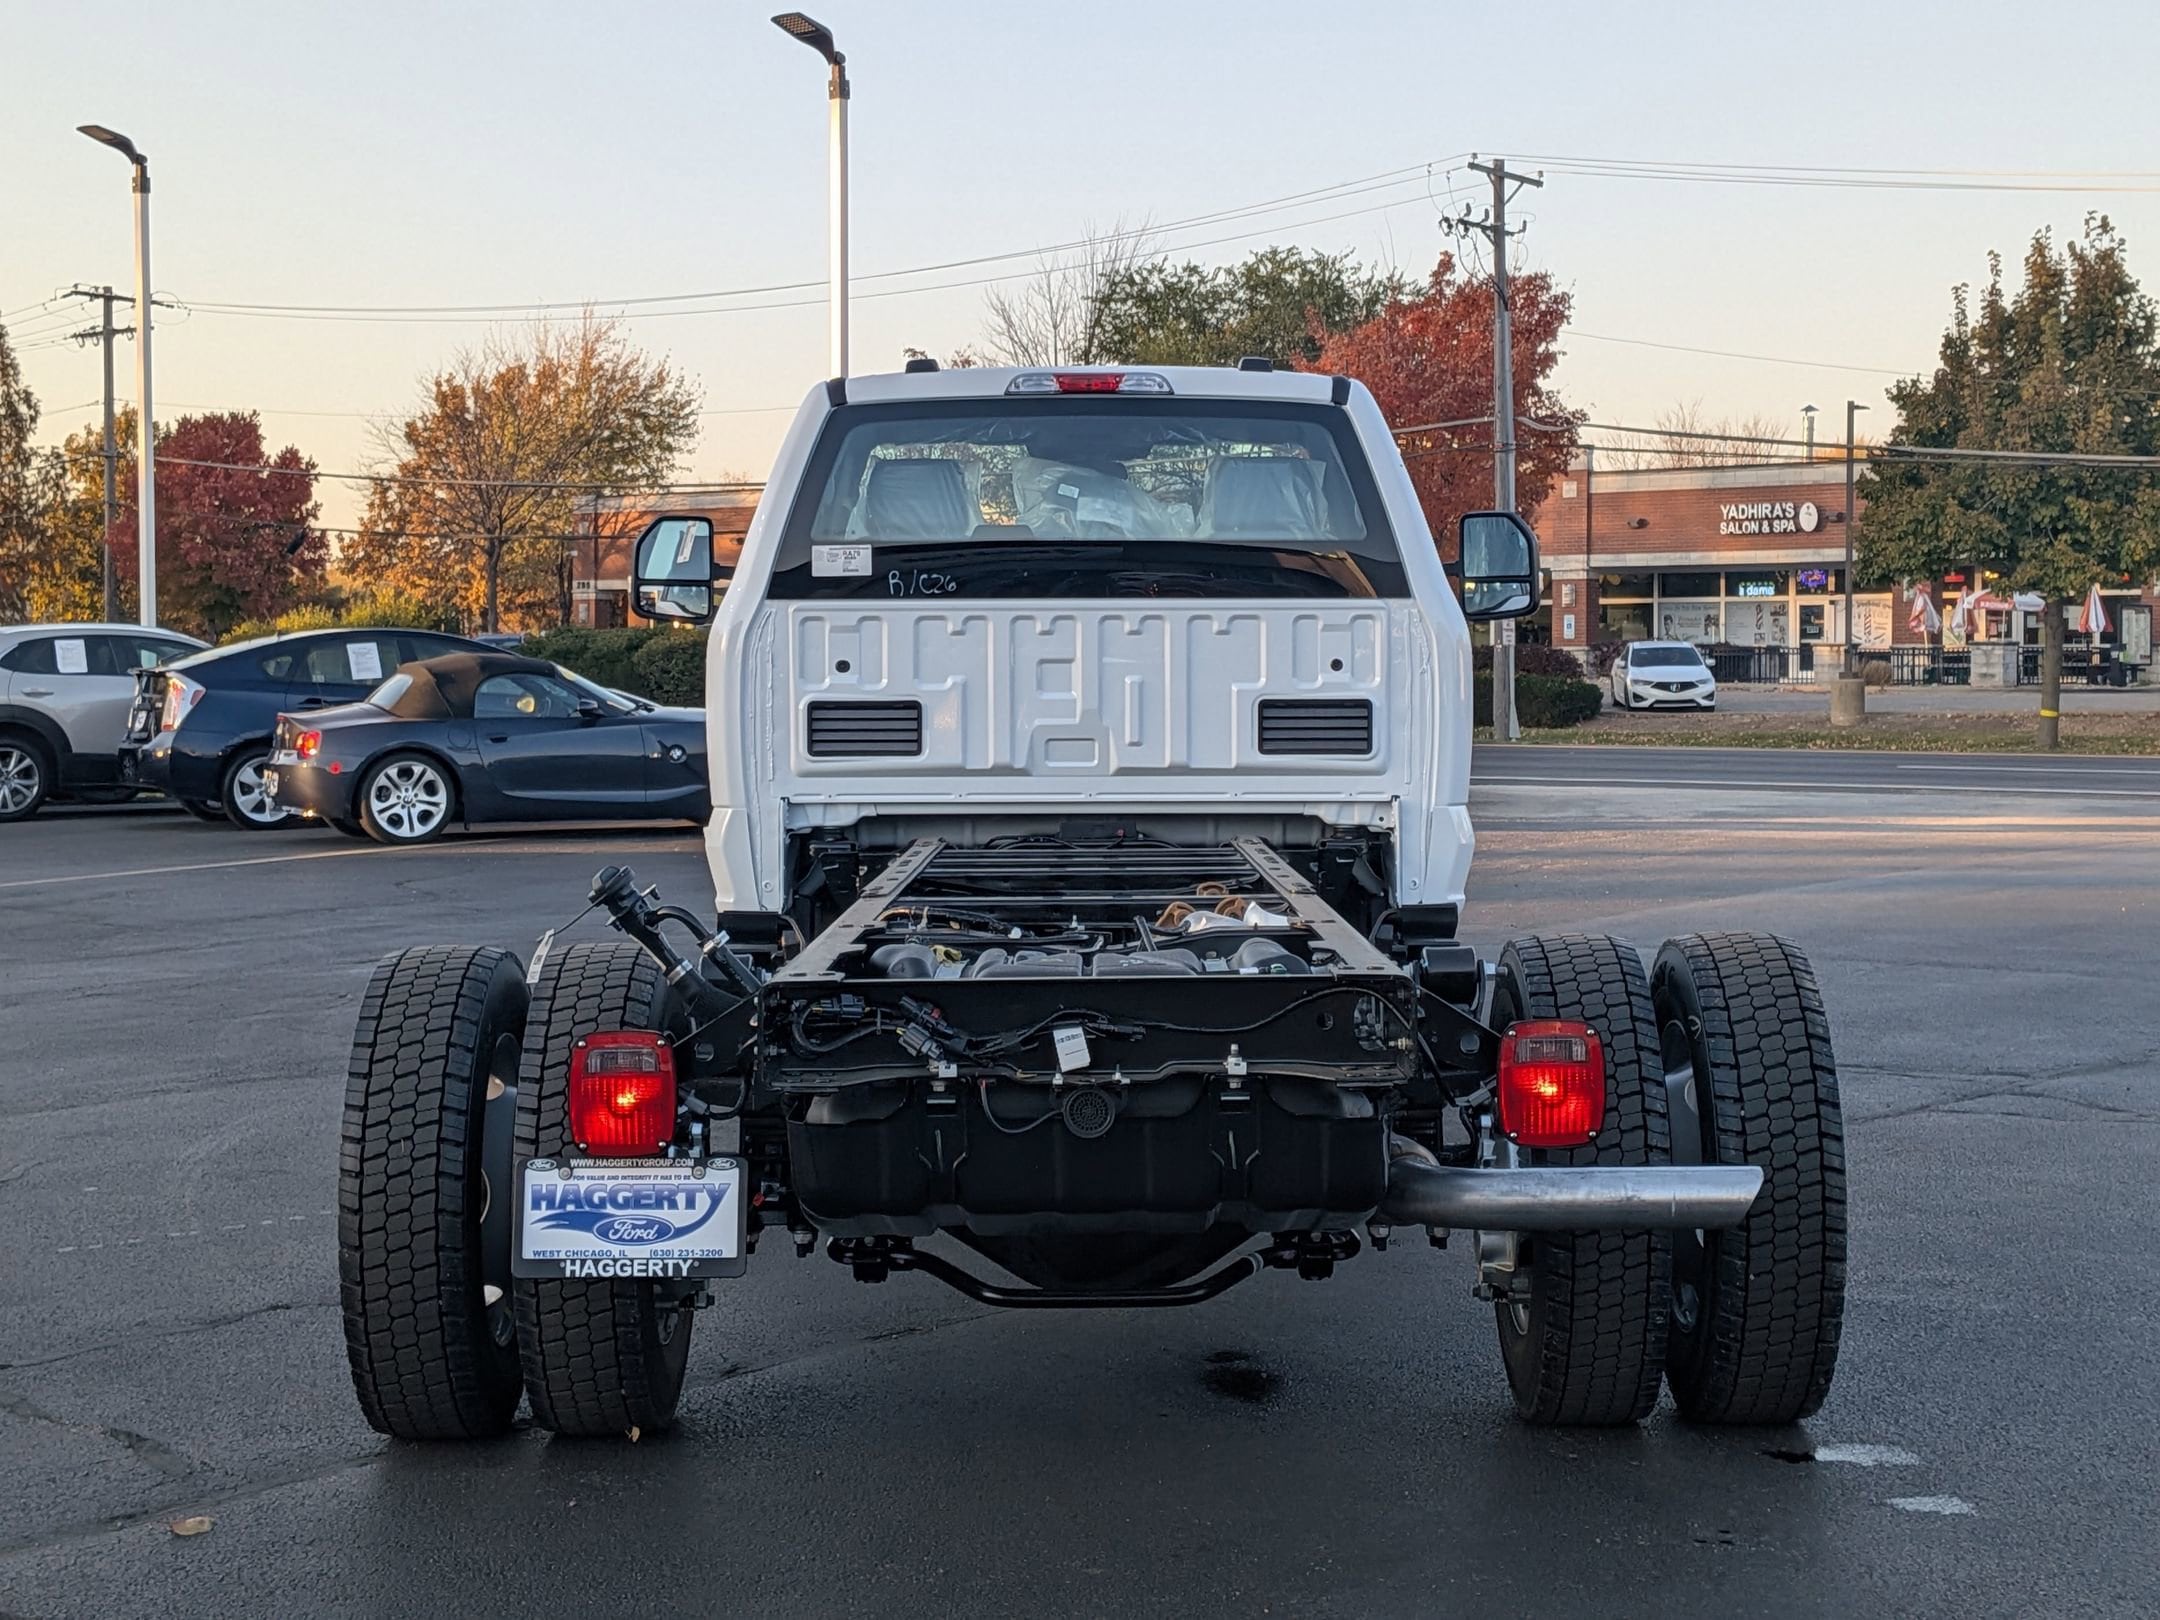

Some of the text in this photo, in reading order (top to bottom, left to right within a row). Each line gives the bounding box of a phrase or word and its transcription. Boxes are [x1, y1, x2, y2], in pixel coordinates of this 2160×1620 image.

[1720, 502, 1795, 520] YADHIRA'S
[1720, 520, 1796, 535] SALON & SPA
[570, 1158, 695, 1168] WWW.HAGGERTYGROUP.COM
[531, 1183, 731, 1212] HAGGERTY
[609, 1218, 658, 1240] Ford
[564, 1250, 616, 1258] CHICAGO,
[650, 1249, 674, 1258] (630)
[677, 1249, 723, 1257] 231-3200
[564, 1259, 694, 1278] HAGGERTY
